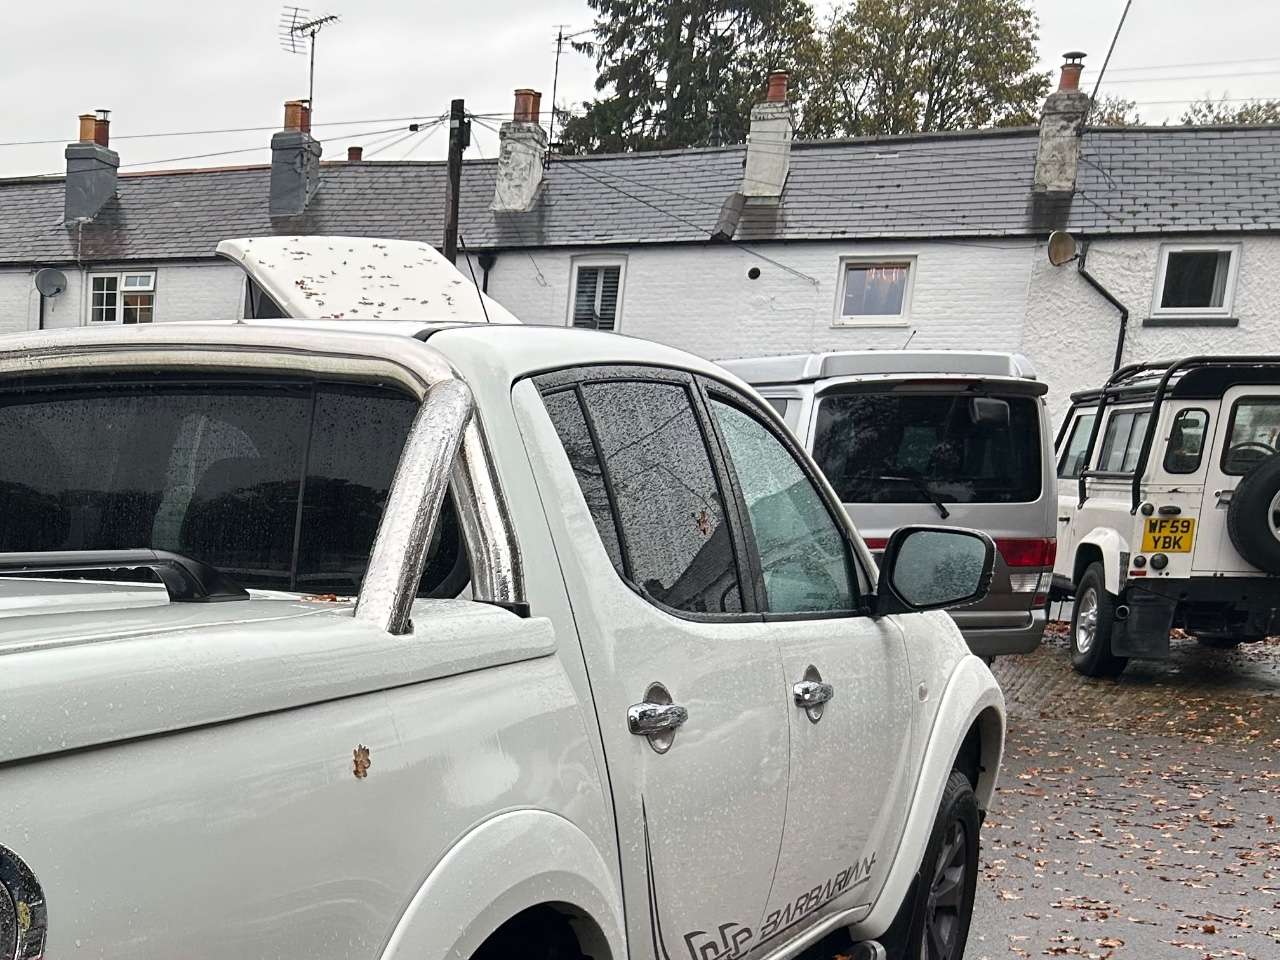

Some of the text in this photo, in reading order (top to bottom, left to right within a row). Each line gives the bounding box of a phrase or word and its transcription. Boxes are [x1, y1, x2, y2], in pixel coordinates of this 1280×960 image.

[1148, 519, 1191, 534] WF59
[1152, 535, 1183, 550] YBK
[760, 851, 876, 939] BARBARIAN
